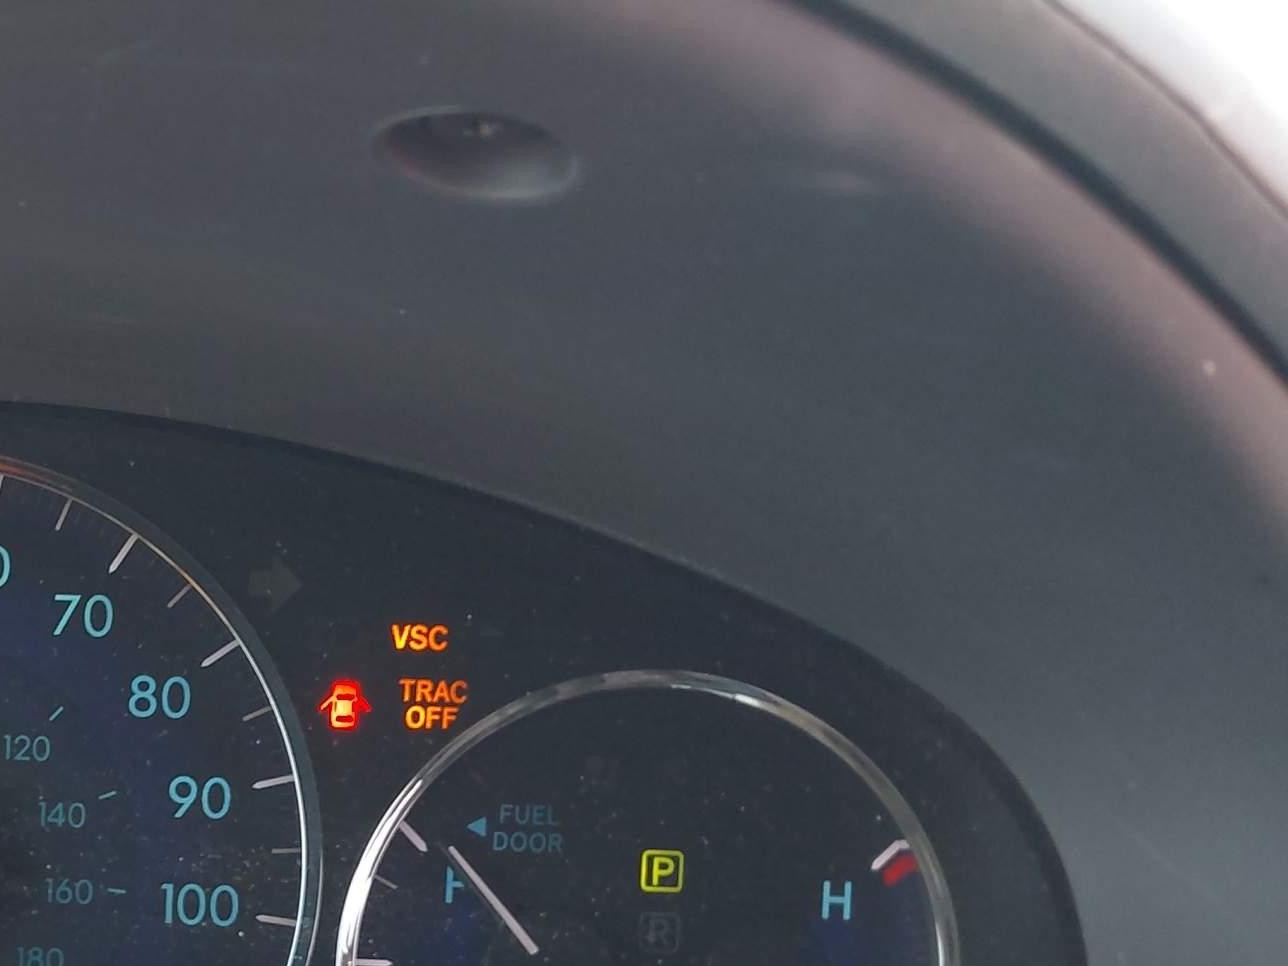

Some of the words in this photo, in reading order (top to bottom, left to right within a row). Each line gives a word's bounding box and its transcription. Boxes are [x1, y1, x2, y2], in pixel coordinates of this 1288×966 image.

[53, 594, 113, 638] 70
[391, 623, 449, 652] VSC
[128, 675, 191, 719] 80
[399, 678, 468, 706] TRAC
[403, 704, 460, 730] OFF
[3, 734, 51, 762] 120
[168, 776, 232, 820] 90
[38, 801, 87, 830] 140
[499, 803, 559, 826] FUEL
[492, 831, 564, 854] DOOR
[45, 877, 94, 905] 160
[160, 883, 239, 927] 100
[821, 880, 852, 921] H
